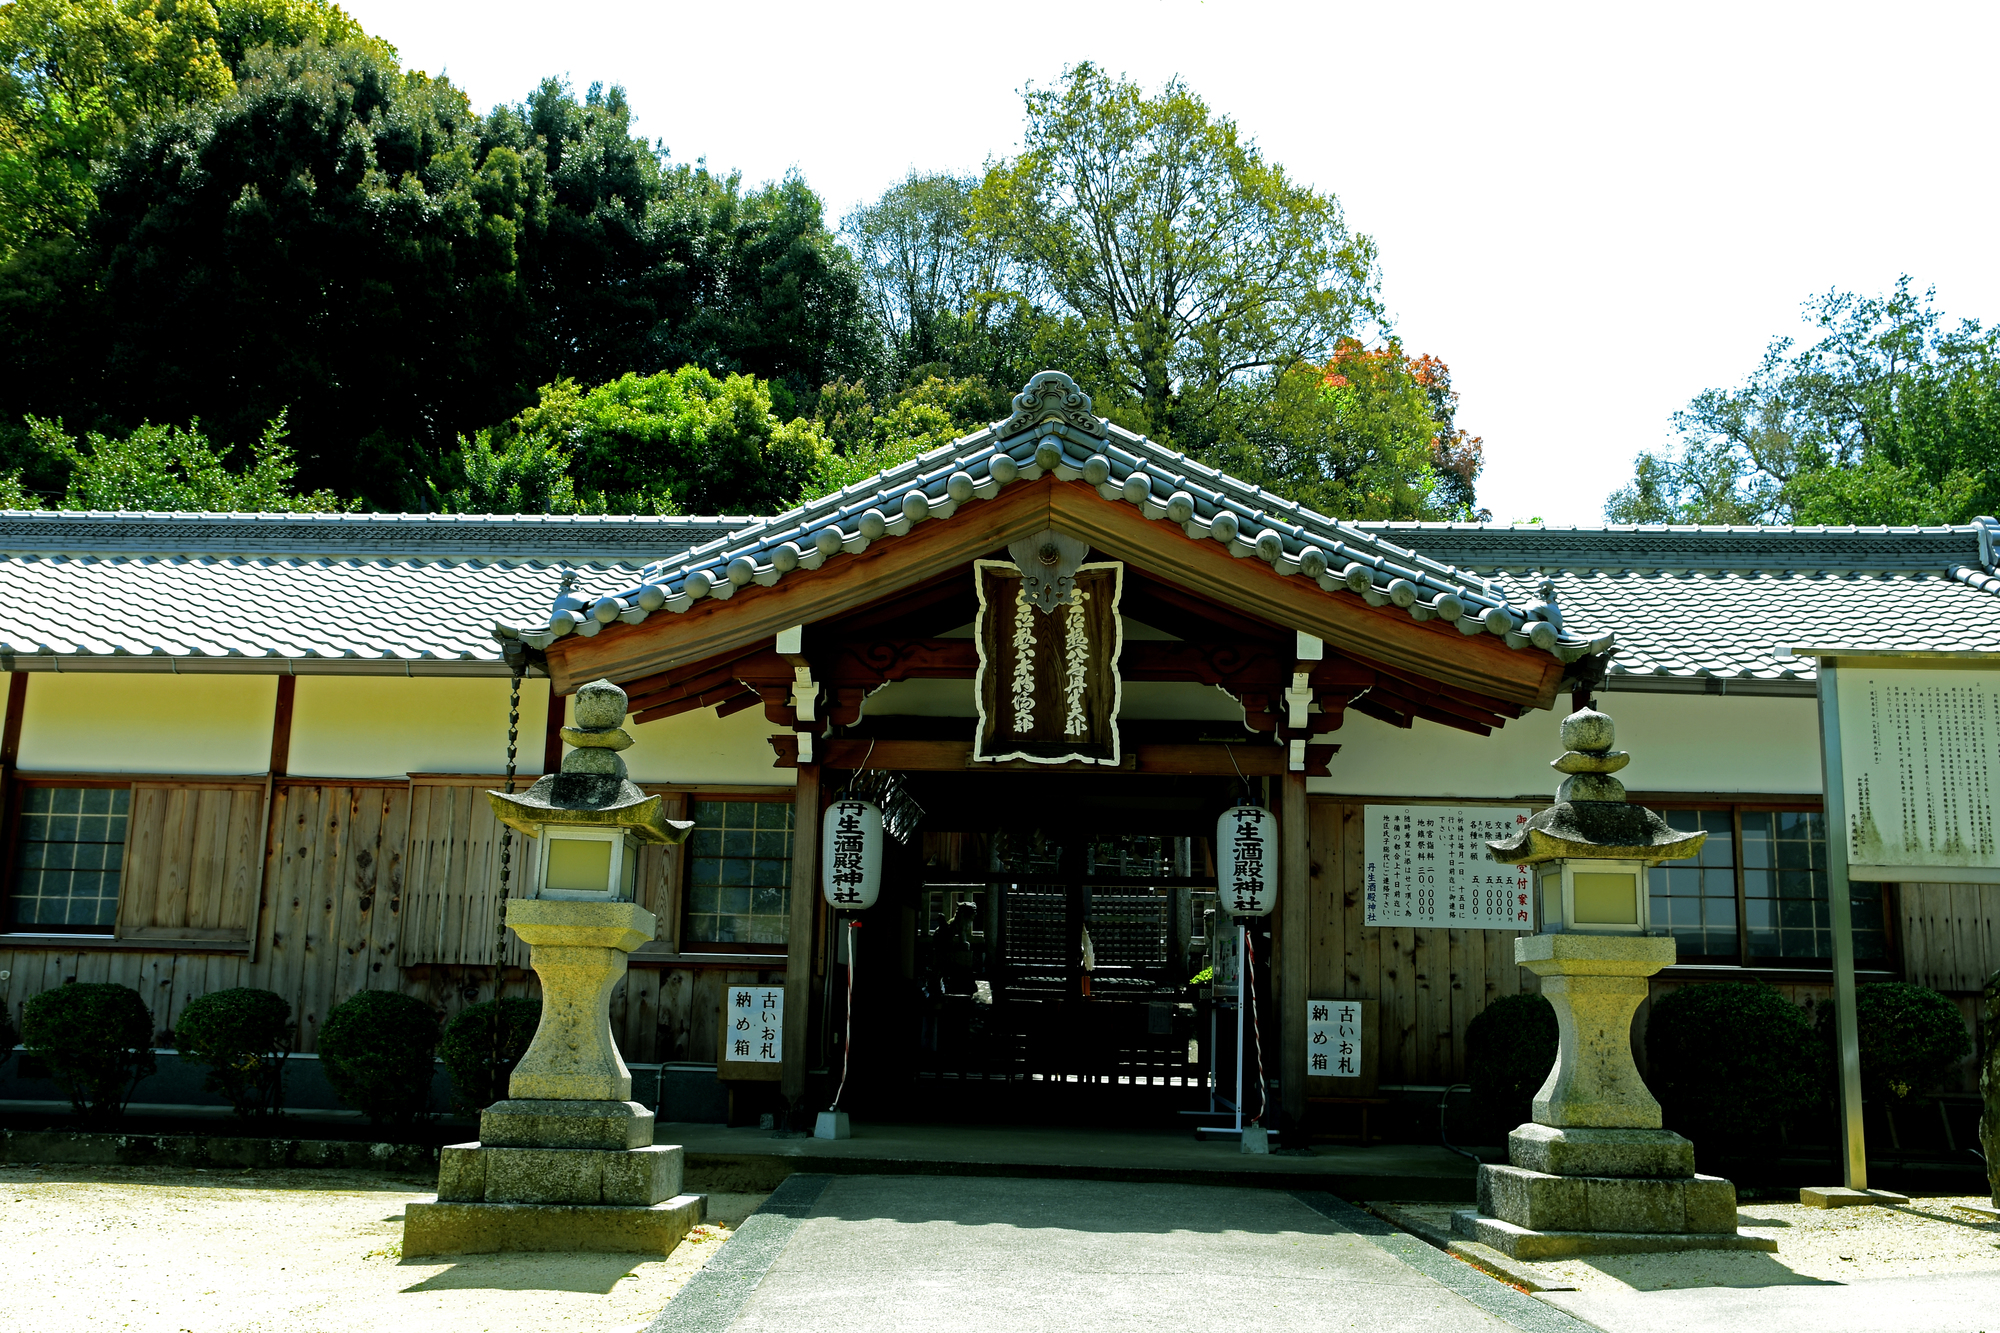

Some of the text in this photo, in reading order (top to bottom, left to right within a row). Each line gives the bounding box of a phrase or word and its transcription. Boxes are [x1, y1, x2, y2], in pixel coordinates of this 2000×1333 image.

[832, 802, 867, 904] 丹生酒殿神社
[1232, 809, 1266, 912] 丹生酒殿神社
[1484, 821, 1494, 861] 厄除願
[1366, 863, 1377, 922] 丹生酒殿神社
[734, 991, 752, 1056] 納め箱
[759, 991, 778, 1059] 古いお札
[1312, 1004, 1329, 1070] 納め箱
[1338, 1005, 1355, 1074] 古いお札
